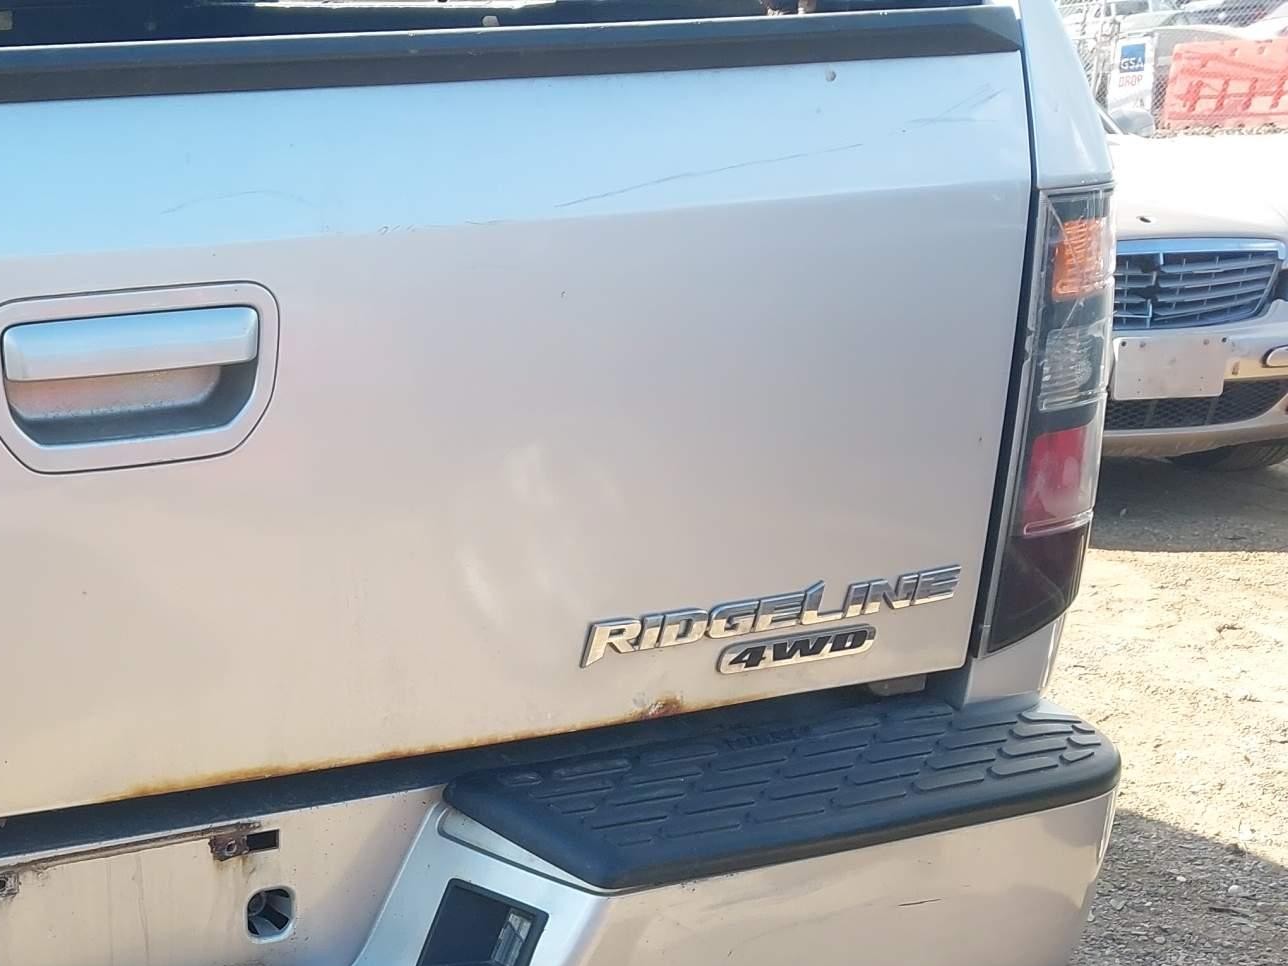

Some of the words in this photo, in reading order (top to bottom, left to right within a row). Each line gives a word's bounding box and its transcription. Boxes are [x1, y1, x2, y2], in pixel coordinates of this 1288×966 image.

[1120, 56, 1144, 70] GSA
[579, 564, 962, 668] RIDGELINE
[728, 629, 871, 670] 4WD
